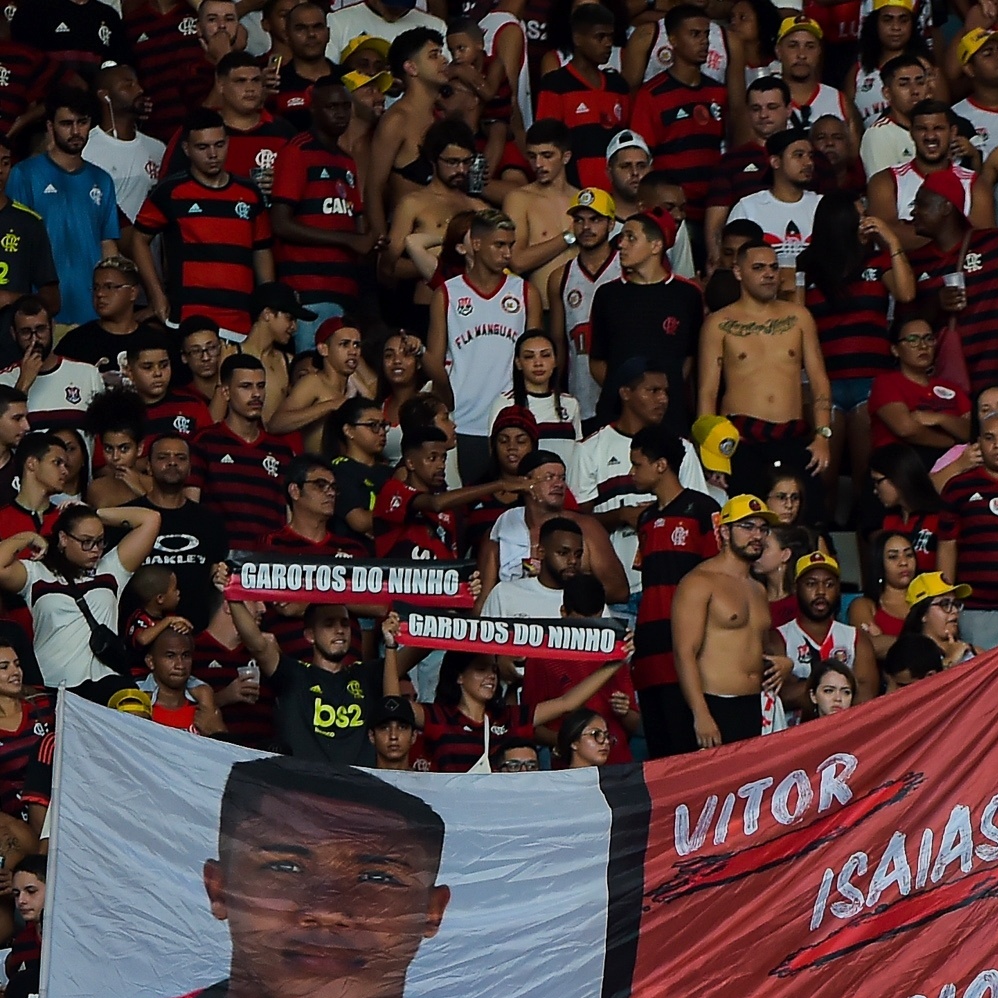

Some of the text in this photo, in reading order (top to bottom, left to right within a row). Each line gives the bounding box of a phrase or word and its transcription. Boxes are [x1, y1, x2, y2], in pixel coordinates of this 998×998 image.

[240, 562, 459, 595] GAROTOS DO NINHO
[408, 613, 616, 653] GAROTOS DO NINHO
[312, 697, 365, 729] bs2
[673, 752, 859, 857] VITOR
